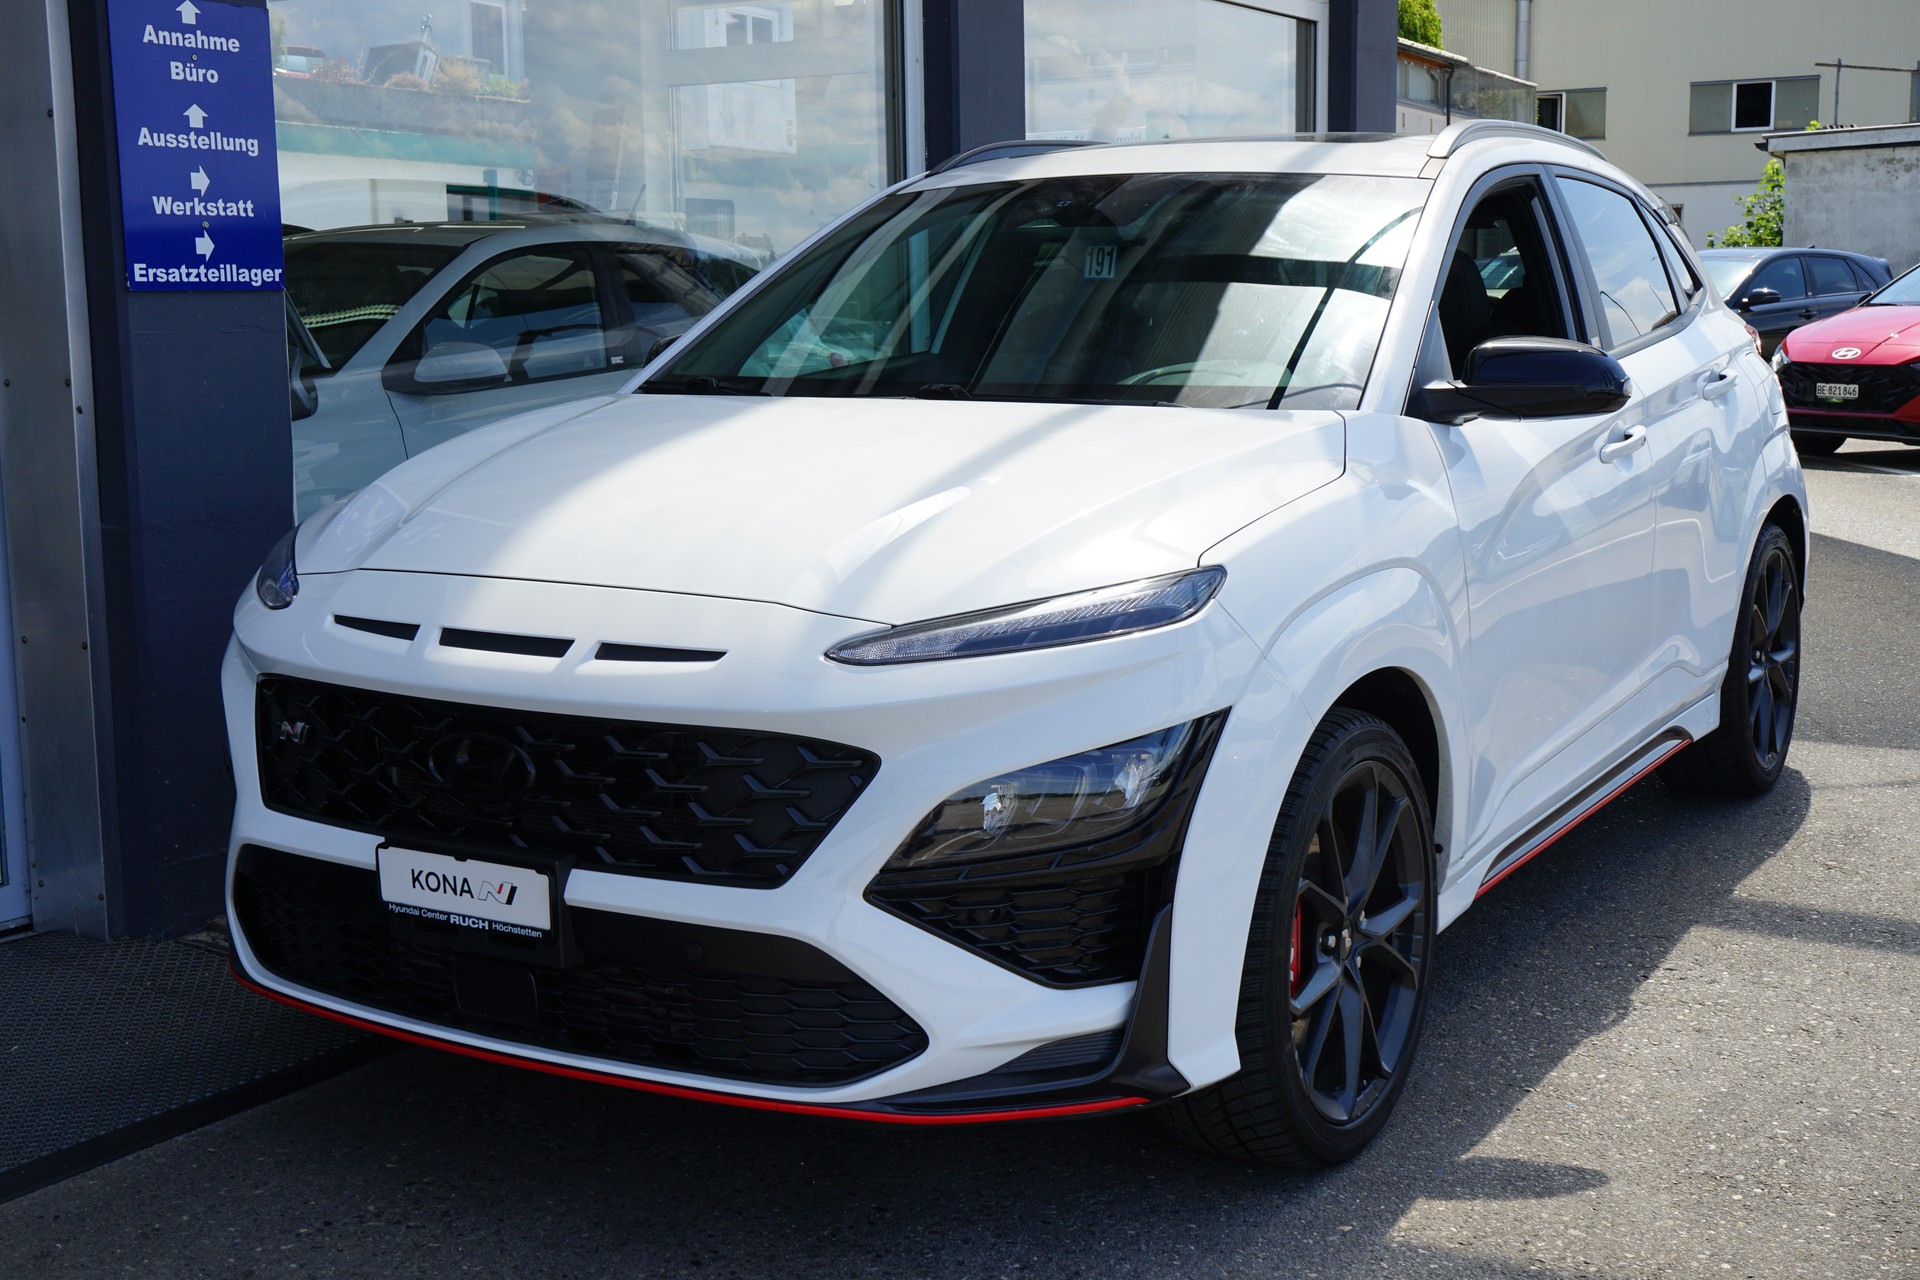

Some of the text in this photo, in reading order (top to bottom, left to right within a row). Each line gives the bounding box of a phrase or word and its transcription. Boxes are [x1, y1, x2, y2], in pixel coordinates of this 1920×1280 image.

[142, 24, 240, 53] Annahme
[170, 61, 219, 84] Büro
[138, 127, 259, 157] Ausstellung
[152, 196, 254, 217] Werkstatt
[133, 263, 282, 287] Ersatzteillager
[1086, 247, 1115, 277] 191
[411, 868, 475, 899] KONA
[388, 902, 542, 939] Hyundai Center RUCH Höchstetten
